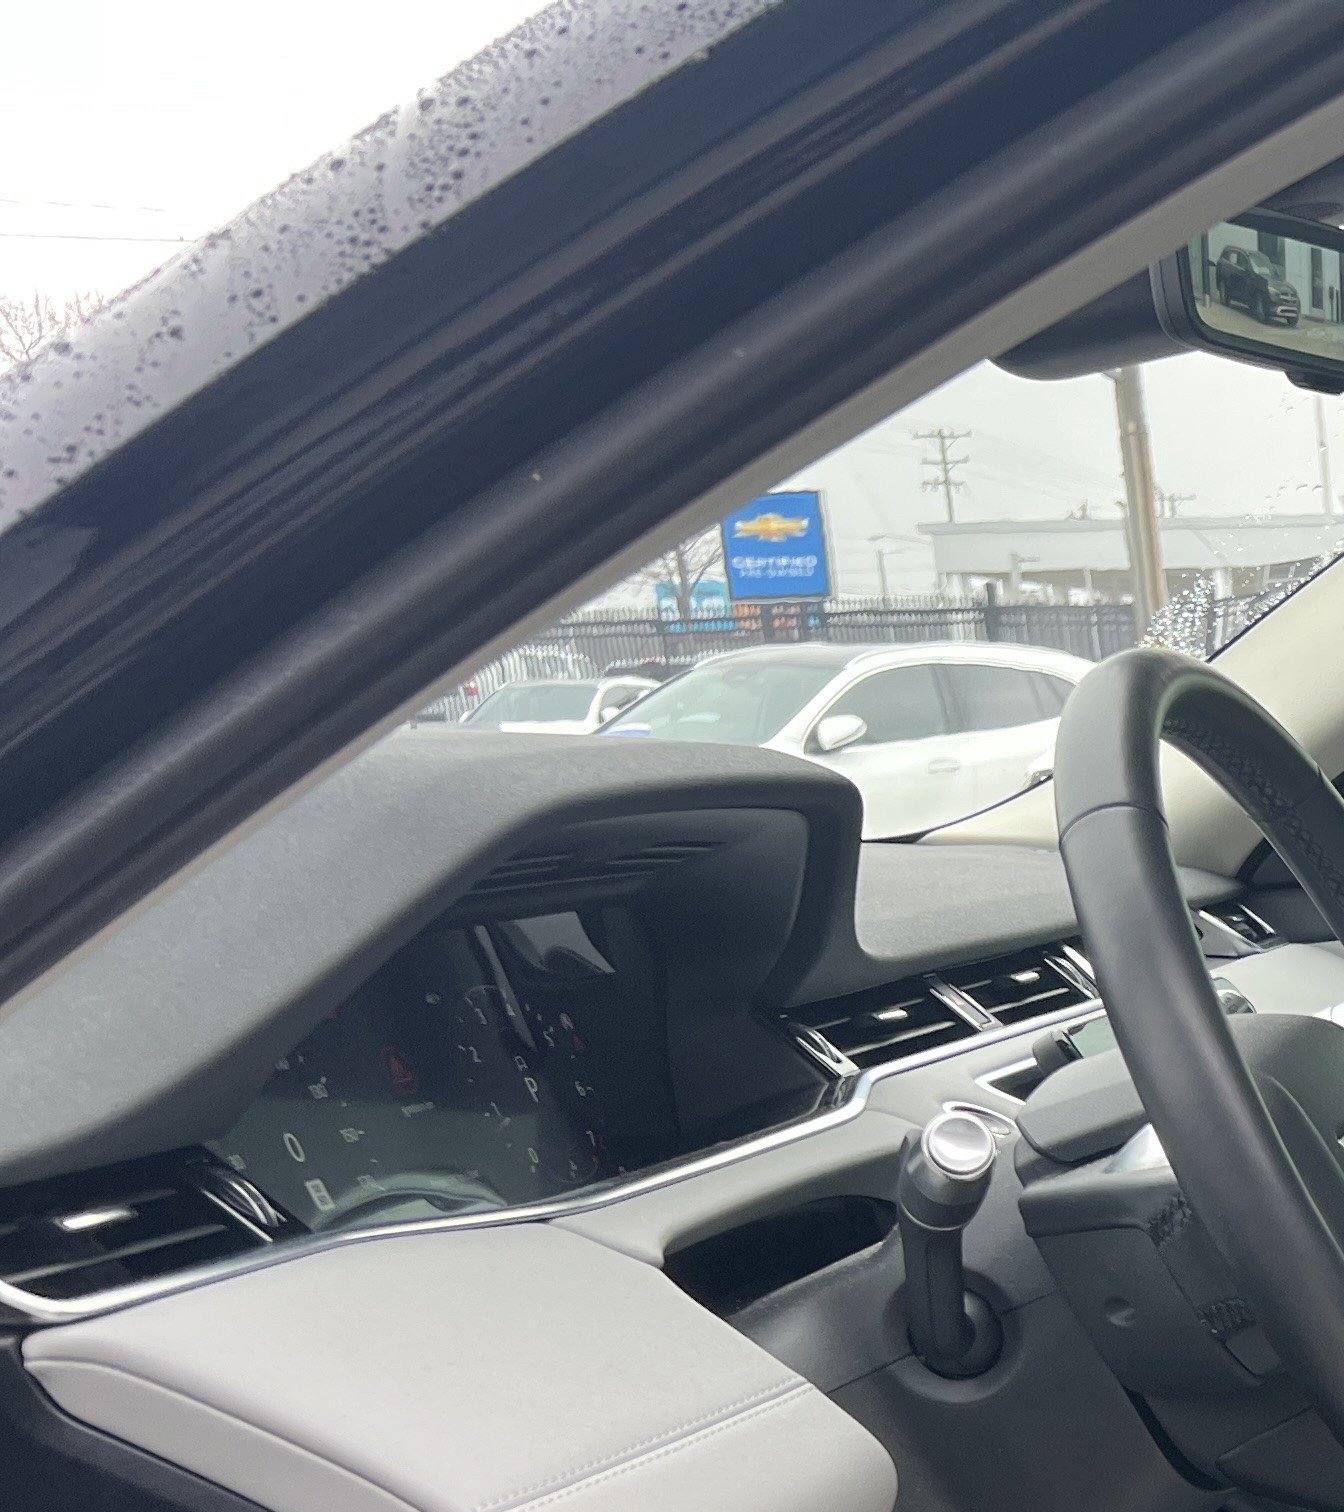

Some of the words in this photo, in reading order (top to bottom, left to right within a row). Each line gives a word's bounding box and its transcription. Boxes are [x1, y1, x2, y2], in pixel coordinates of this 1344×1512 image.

[524, 1077, 540, 1103] P
[574, 1080, 587, 1097] 6
[282, 1132, 306, 1164] 0
[527, 1147, 540, 1164] 0
